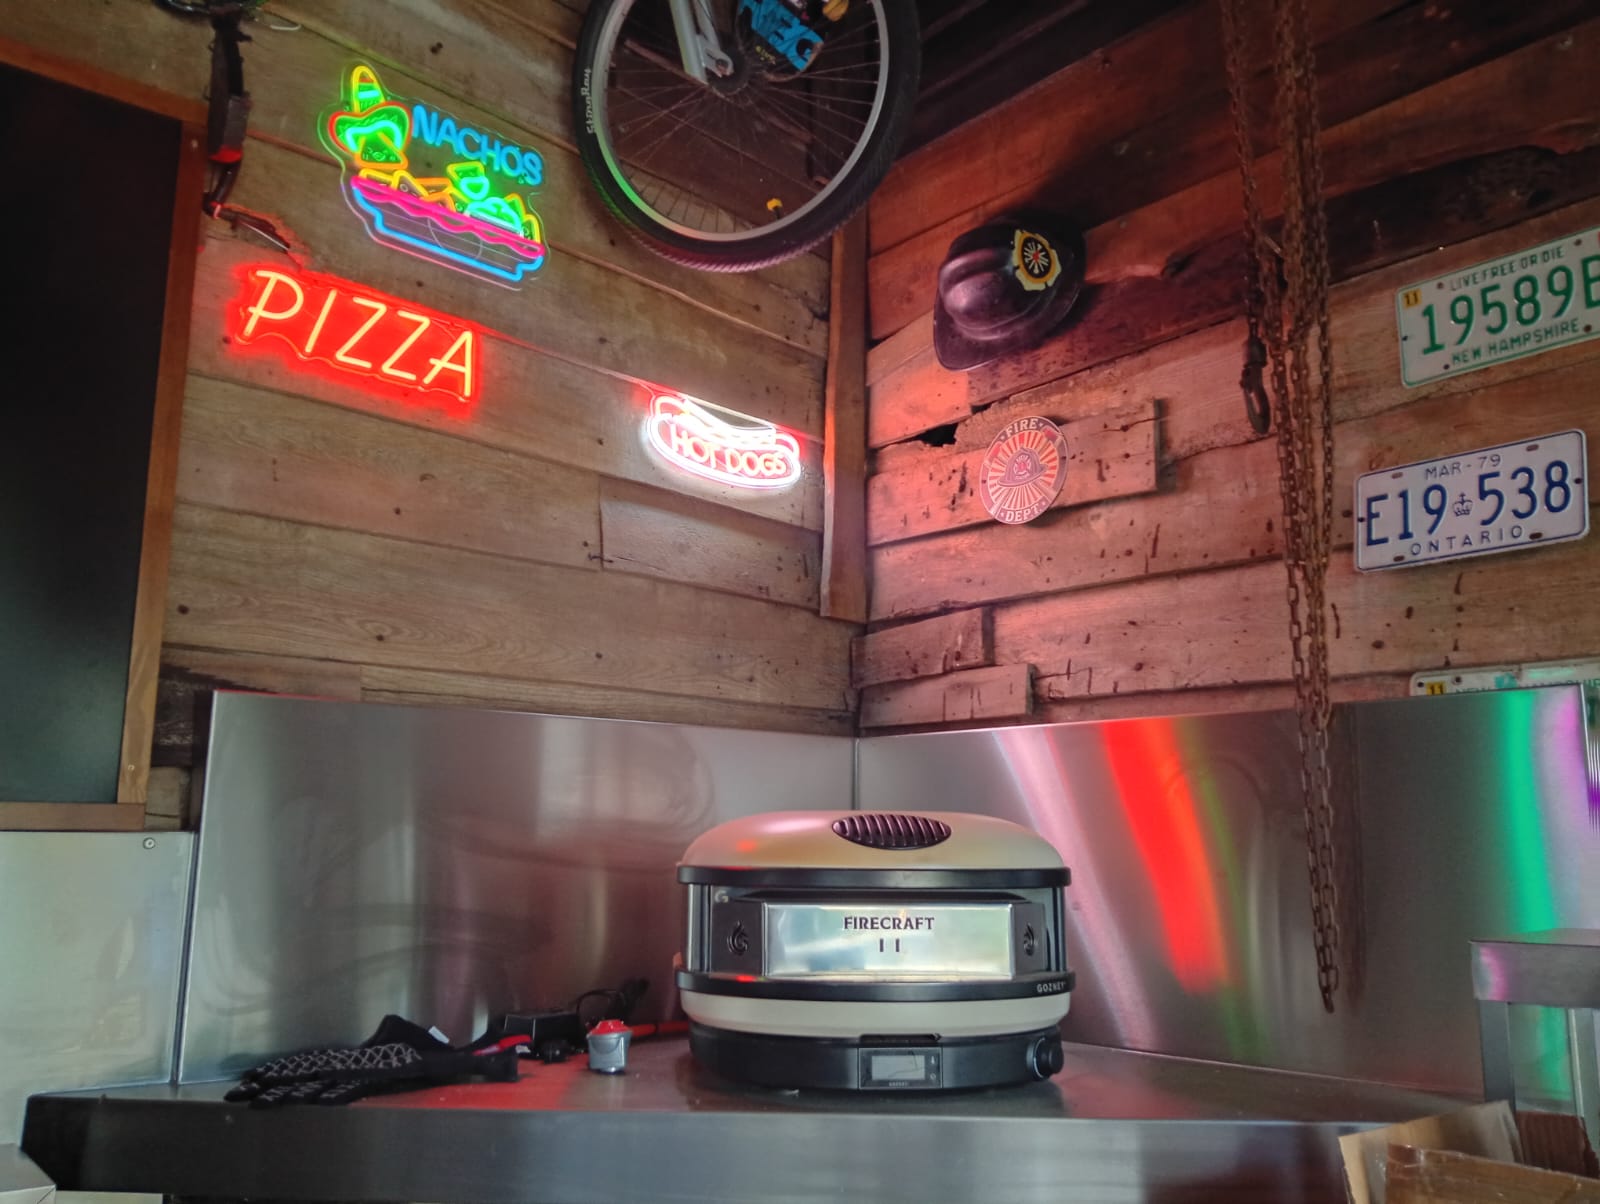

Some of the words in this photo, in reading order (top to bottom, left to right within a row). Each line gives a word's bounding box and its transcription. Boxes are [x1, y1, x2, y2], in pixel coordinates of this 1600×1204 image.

[412, 105, 543, 186] NACHOS
[1450, 272, 1478, 292] LIVE
[1482, 262, 1517, 281] FREE
[1521, 254, 1538, 269] OR
[1542, 246, 1565, 263] DIE
[1404, 291, 1420, 306] 11
[244, 269, 473, 397] PIZZA
[1452, 346, 1482, 364] NEW
[1488, 318, 1580, 356] HAMPSHIRE
[669, 423, 720, 470] HOT
[724, 449, 788, 477] DOGS
[1005, 418, 1040, 438] FIRE
[1004, 503, 1040, 523] DEPT
[1478, 460, 1572, 527] 538
[1409, 525, 1524, 556] ONTARIO
[843, 916, 935, 930] FIRECRAFT
